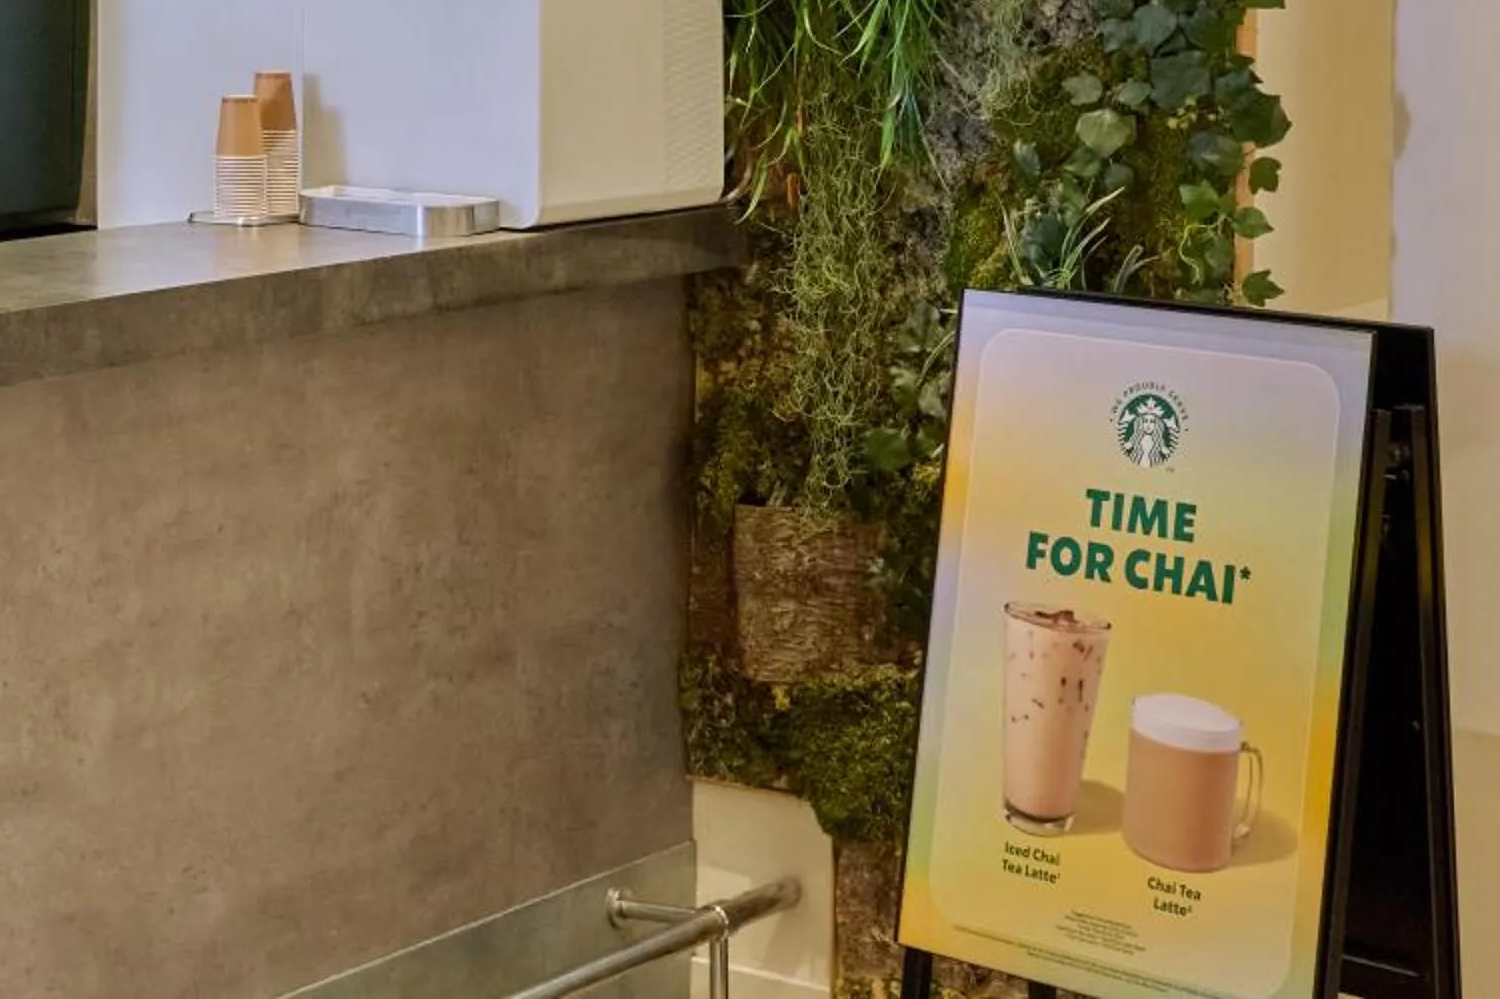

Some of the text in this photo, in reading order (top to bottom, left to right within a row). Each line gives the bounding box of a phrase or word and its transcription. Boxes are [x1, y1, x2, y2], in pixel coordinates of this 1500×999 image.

[1085, 488, 1197, 543] TIME
[1026, 531, 1115, 583] FOR
[1004, 841, 1060, 866] Iced Chai
[1002, 859, 1022, 875] Tea
[1147, 877, 1201, 901] Chai Tea
